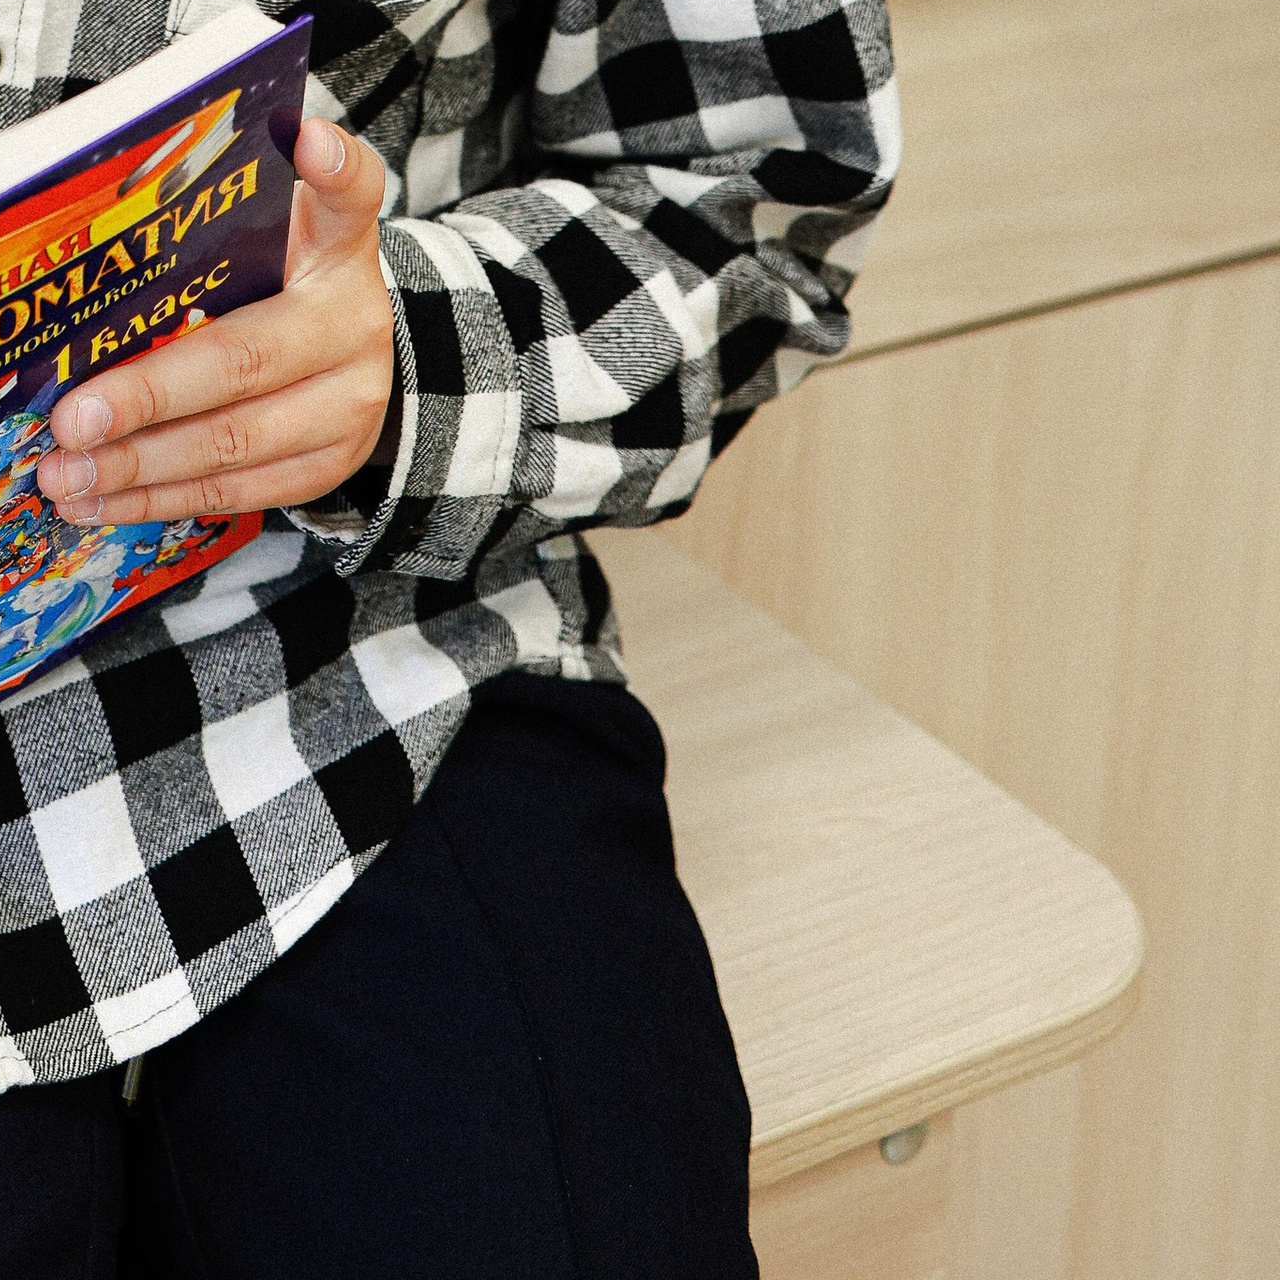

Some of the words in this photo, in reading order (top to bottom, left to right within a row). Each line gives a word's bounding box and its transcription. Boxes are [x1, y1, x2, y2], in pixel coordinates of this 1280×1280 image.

[51, 345, 73, 387] 1
[88, 257, 232, 366] класс
[71, 253, 179, 324] школы
